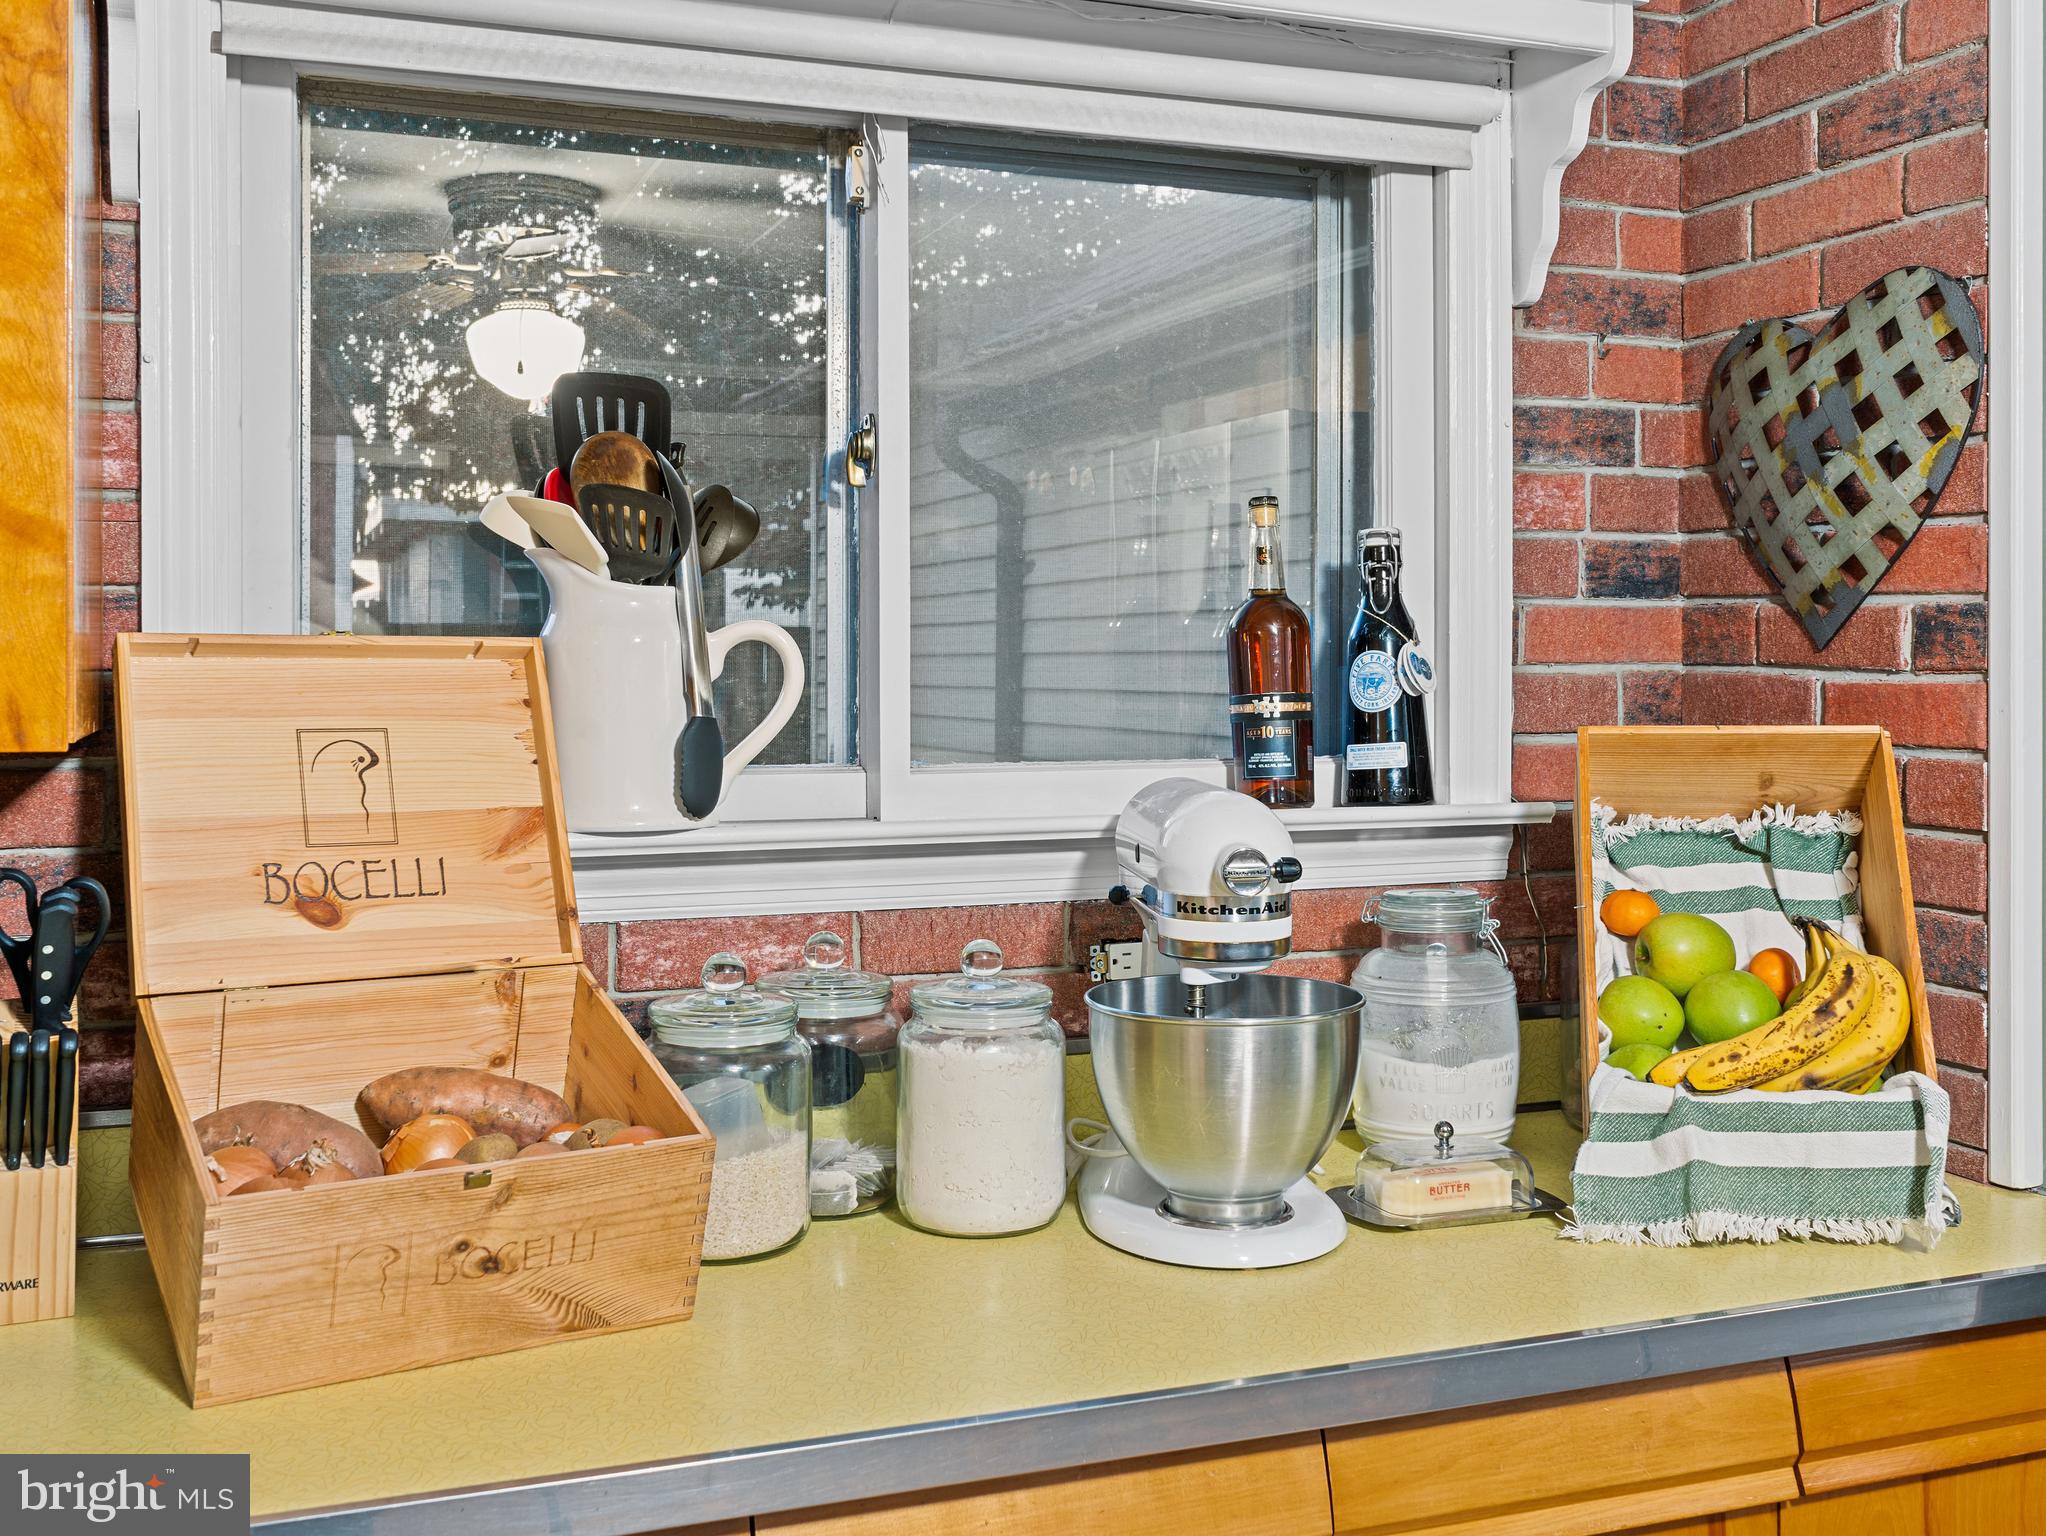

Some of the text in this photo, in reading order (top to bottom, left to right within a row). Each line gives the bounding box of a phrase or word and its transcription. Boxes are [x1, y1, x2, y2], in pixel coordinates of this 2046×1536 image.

[1261, 725, 1275, 739] 10
[1274, 728, 1292, 736] YEARS
[261, 856, 447, 905] BOCELLI
[1176, 900, 1287, 916] KitchenAid
[1429, 1182, 1471, 1196] BUTTER
[431, 1230, 597, 1286] BOCELLI
